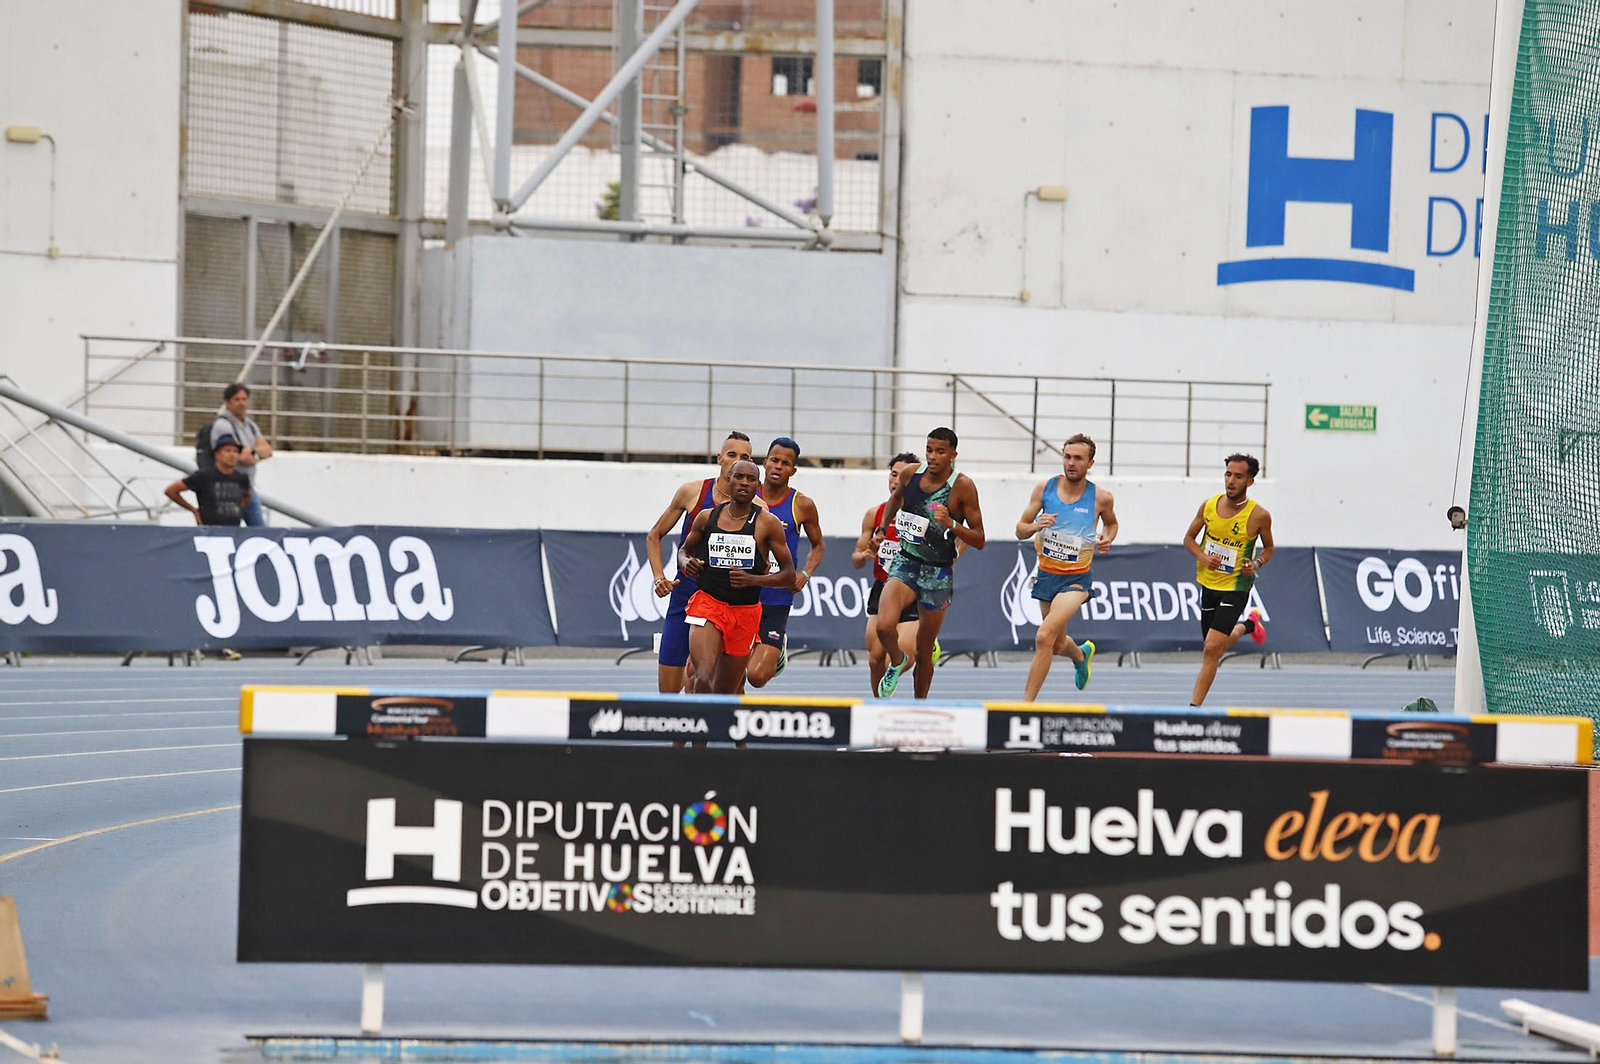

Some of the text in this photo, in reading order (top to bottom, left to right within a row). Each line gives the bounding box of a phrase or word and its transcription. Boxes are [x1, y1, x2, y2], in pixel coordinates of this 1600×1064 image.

[710, 544, 752, 554] KIPSANG
[194, 535, 454, 639] Joma
[1366, 626, 1459, 648] Life_Science_T
[623, 716, 708, 733] IBERDROLA
[728, 709, 835, 741] Joma
[1062, 731, 1116, 746] HUELVA
[1153, 719, 1204, 737] Huelva
[482, 790, 757, 846] DIPUTACIÓN
[995, 788, 1441, 864] Huelva eleva
[482, 842, 754, 884] DE HUELVA
[481, 880, 653, 913] OBJETIVOS
[990, 881, 1442, 951] tus sentidos.
